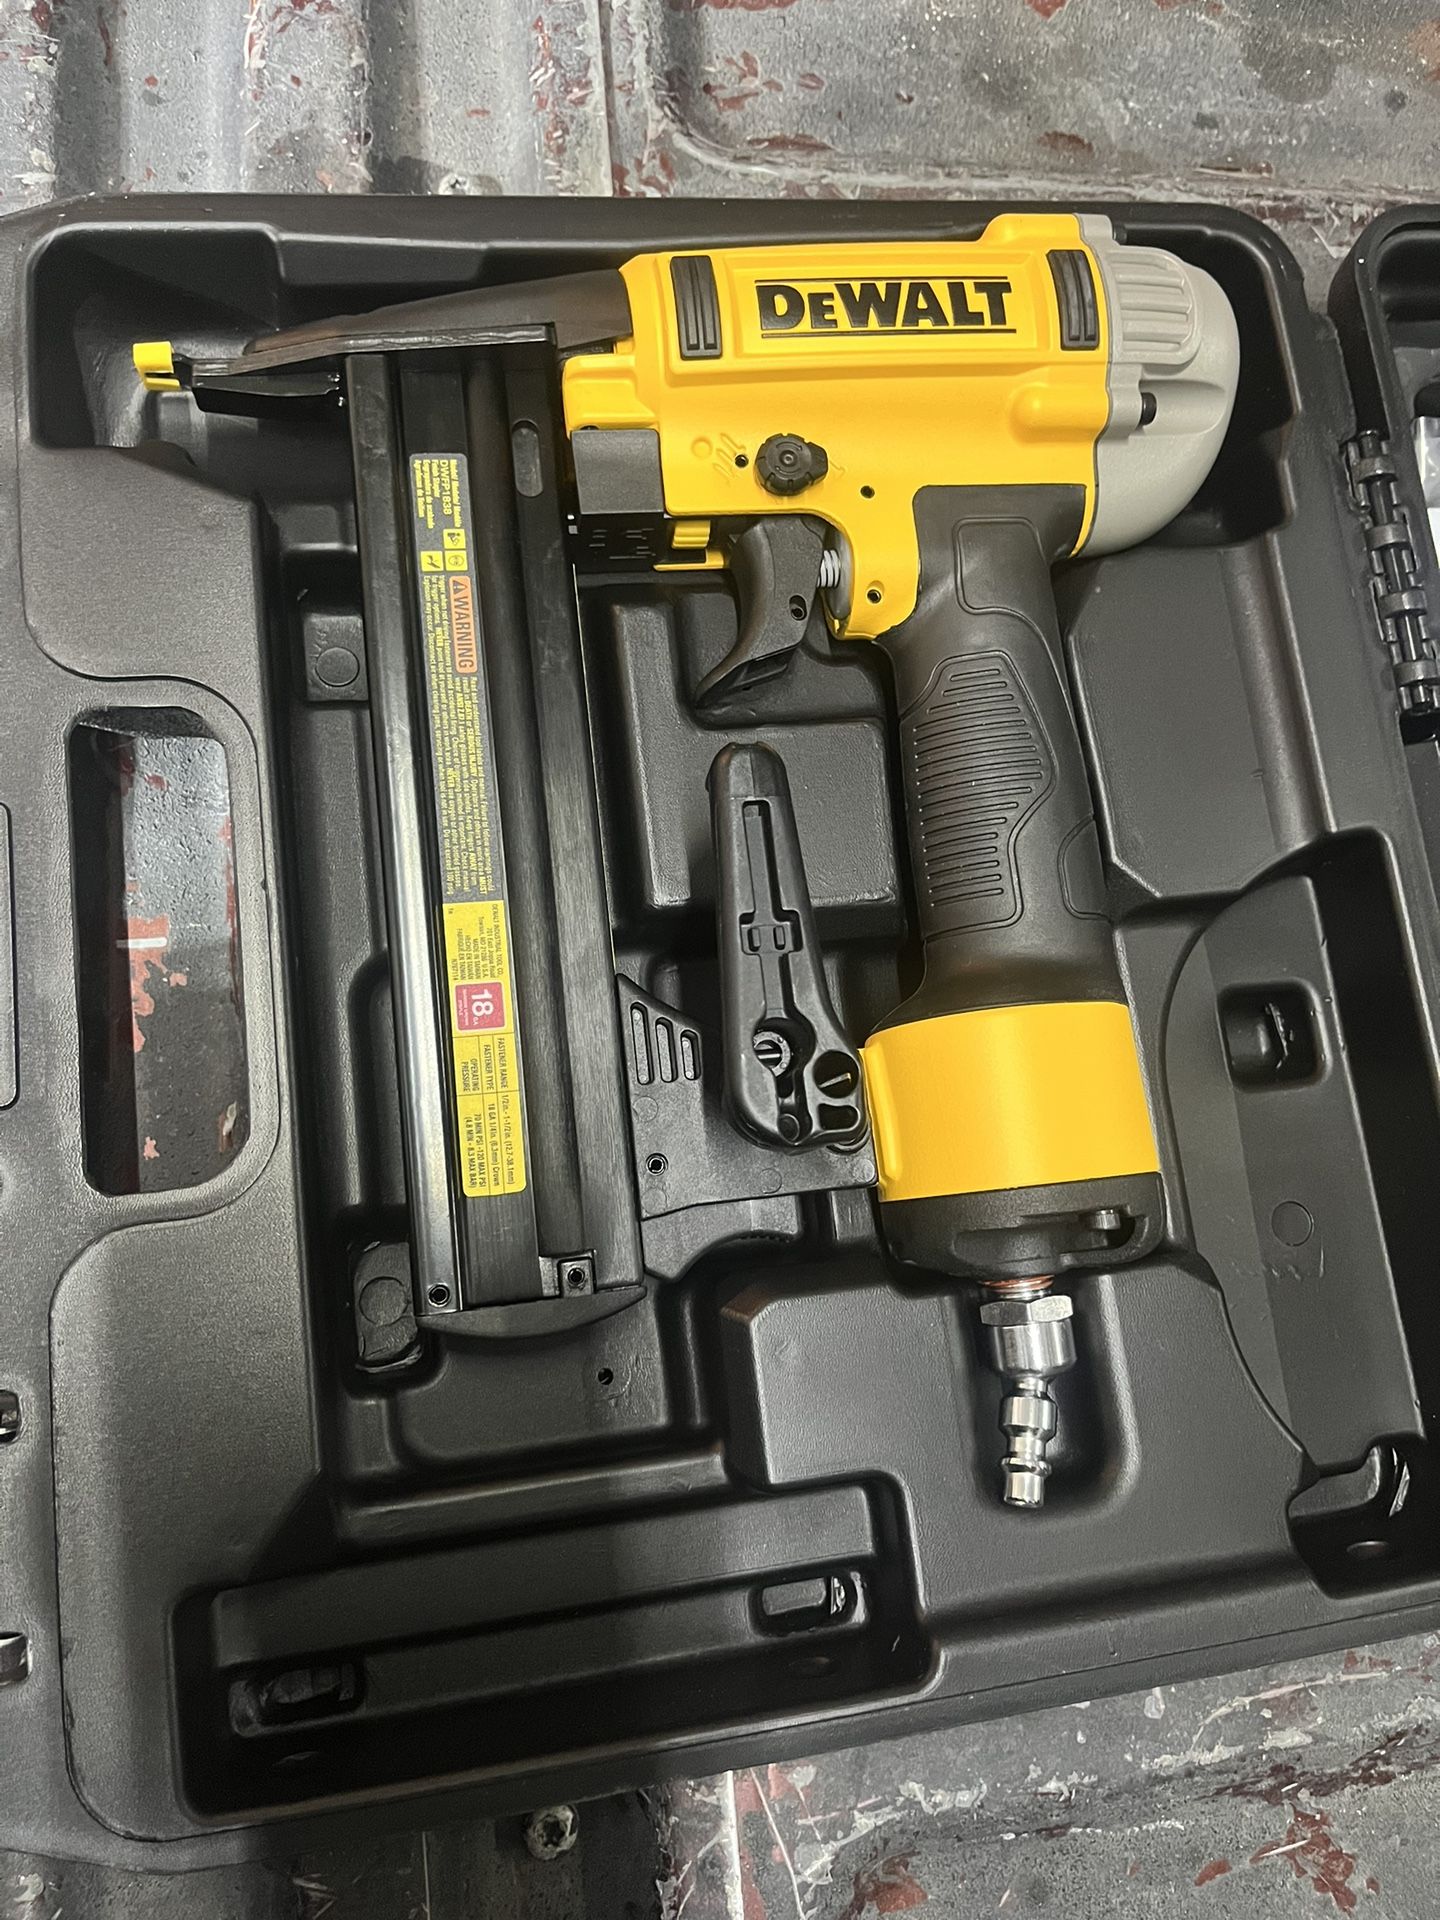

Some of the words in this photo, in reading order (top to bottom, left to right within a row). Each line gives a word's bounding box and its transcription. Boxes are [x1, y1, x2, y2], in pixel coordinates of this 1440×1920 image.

[430, 459, 439, 476] Finish
[432, 477, 440, 497] Stapler
[439, 459, 452, 514] DWFP1838
[421, 575, 431, 601] Explosion
[430, 583, 439, 601] trigger
[424, 602, 432, 613] may
[439, 595, 447, 609] when
[440, 610, 448, 619] not
[434, 627, 442, 646] NEVER
[441, 620, 450, 639] driving
[452, 595, 473, 668] WARNING
[426, 633, 436, 663] Disconnect
[443, 640, 452, 666] fasteners
[437, 662, 445, 673] tool
[445, 673, 454, 688] avoid
[454, 677, 462, 691] wear
[431, 690, 440, 712] clearing
[438, 681, 447, 703] yourself
[455, 692, 463, 707] ANSI
[447, 690, 456, 718] accidental
[441, 711, 449, 728] others
[472, 704, 481, 735] understand
[434, 730, 443, 755] servicing
[458, 725, 466, 742] safety
[466, 727, 474, 753] SERIOUS
[474, 736, 482, 747] tool
[450, 736, 459, 756] Choice
[459, 743, 468, 765] glasses
[475, 748, 483, 764] labels
[445, 767, 454, 787] NEVER
[461, 766, 469, 778] with
[438, 781, 446, 791] tool
[462, 780, 470, 791] side
[470, 779, 479, 807] Operators
[440, 799, 448, 808] not
[448, 800, 457, 820] oxygen
[455, 793, 464, 814] method
[480, 801, 488, 820] Failure
[465, 815, 473, 830] Keep
[472, 808, 480, 819] and
[442, 829, 450, 837] Do
[450, 828, 459, 844] other
[473, 820, 481, 838] others
[466, 831, 475, 851] fingers
[444, 849, 453, 870] exceed
[460, 851, 468, 869] Check
[468, 852, 476, 870] AWAY
[475, 846, 483, 860] work
[483, 847, 492, 873] warnings
[478, 876, 486, 895] MUST
[470, 988, 494, 1017] 18
[483, 1044, 492, 1073] FASTENER
[497, 1037, 506, 1067] FASTENER
[461, 1061, 470, 1091] PRESSURE
[470, 1058, 479, 1091] OPERATING
[485, 1075, 494, 1089] TYPE
[499, 1068, 508, 1088] RANGE
[463, 1116, 472, 1128] (4.8
[474, 1122, 482, 1134] MIN
[464, 1129, 473, 1141] MIN
[475, 1135, 483, 1145] PSI
[487, 1111, 495, 1120] GA
[491, 1166, 501, 1186] Crown
[467, 1157, 476, 1172] MAX
[468, 1172, 477, 1187] BAR)
